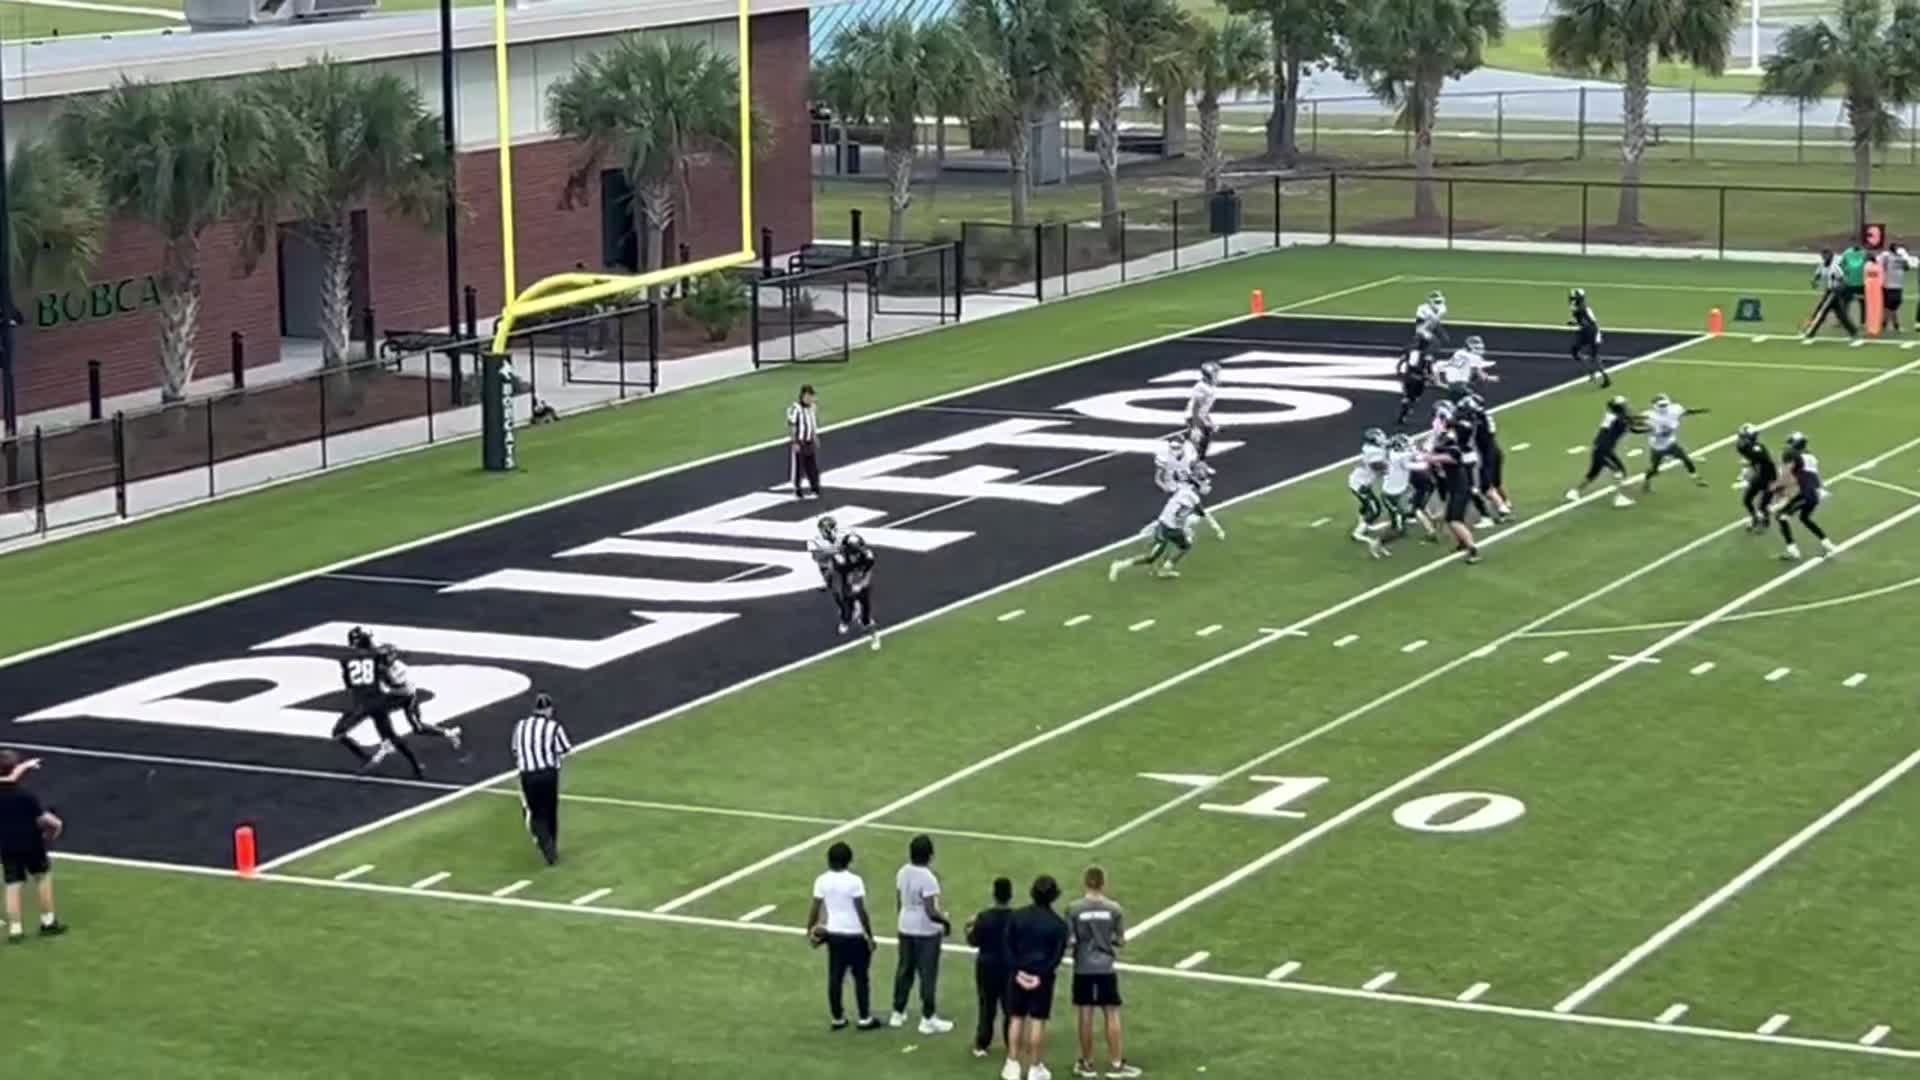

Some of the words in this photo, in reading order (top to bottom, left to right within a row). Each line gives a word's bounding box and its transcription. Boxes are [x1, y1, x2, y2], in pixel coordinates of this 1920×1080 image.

[1866, 226, 1881, 246] 3
[36, 275, 161, 327] BOBCA
[13, 351, 1404, 746] BLUFFTON
[348, 659, 375, 685] 28
